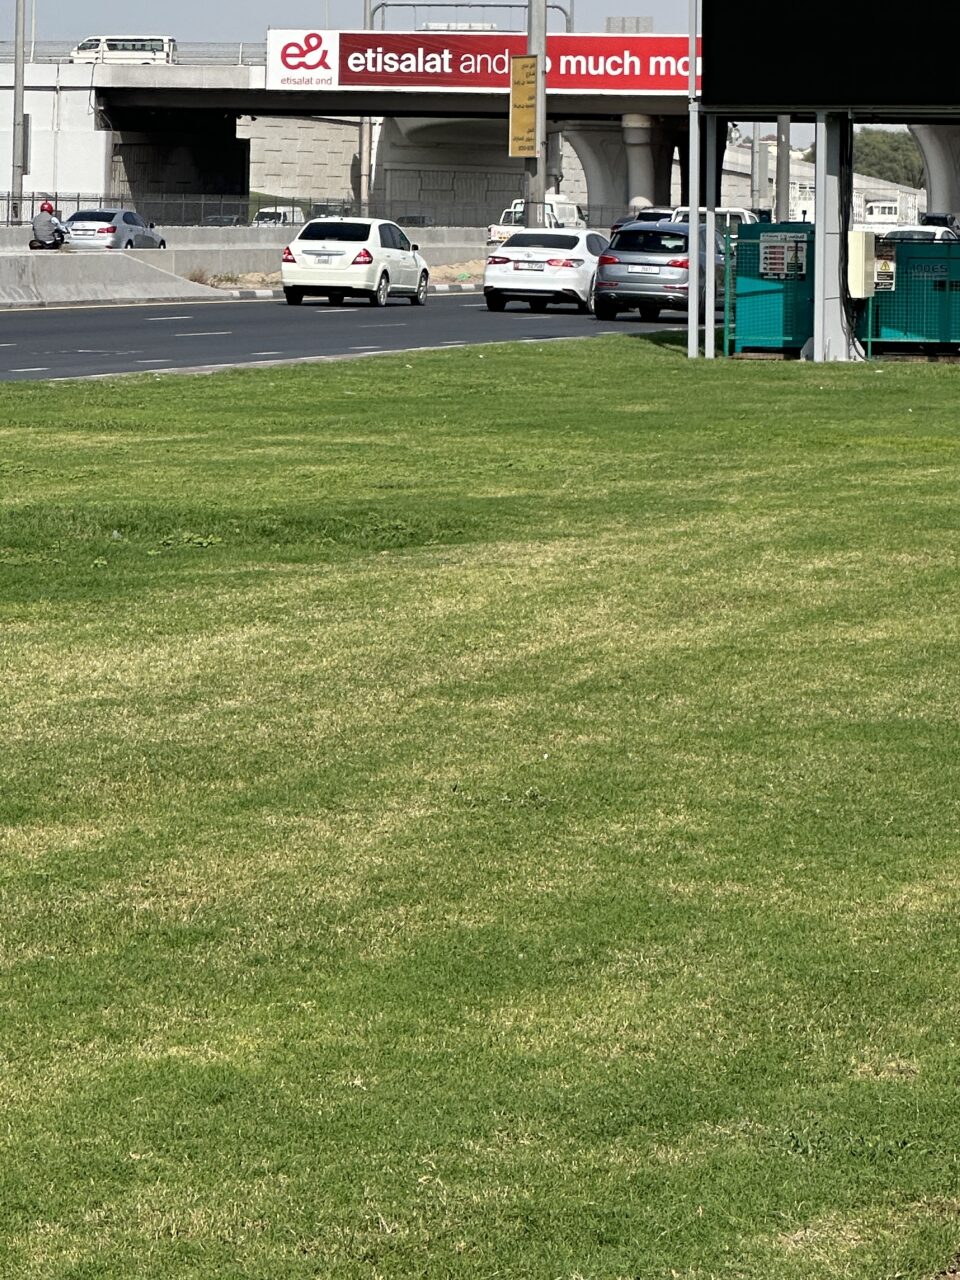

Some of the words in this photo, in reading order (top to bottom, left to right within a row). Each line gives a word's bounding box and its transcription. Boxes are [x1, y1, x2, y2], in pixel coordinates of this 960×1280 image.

[347, 47, 453, 74] etisalat
[459, 47, 509, 74] and
[559, 50, 641, 76] much
[280, 75, 314, 86] etisalat
[315, 76, 333, 86] and
